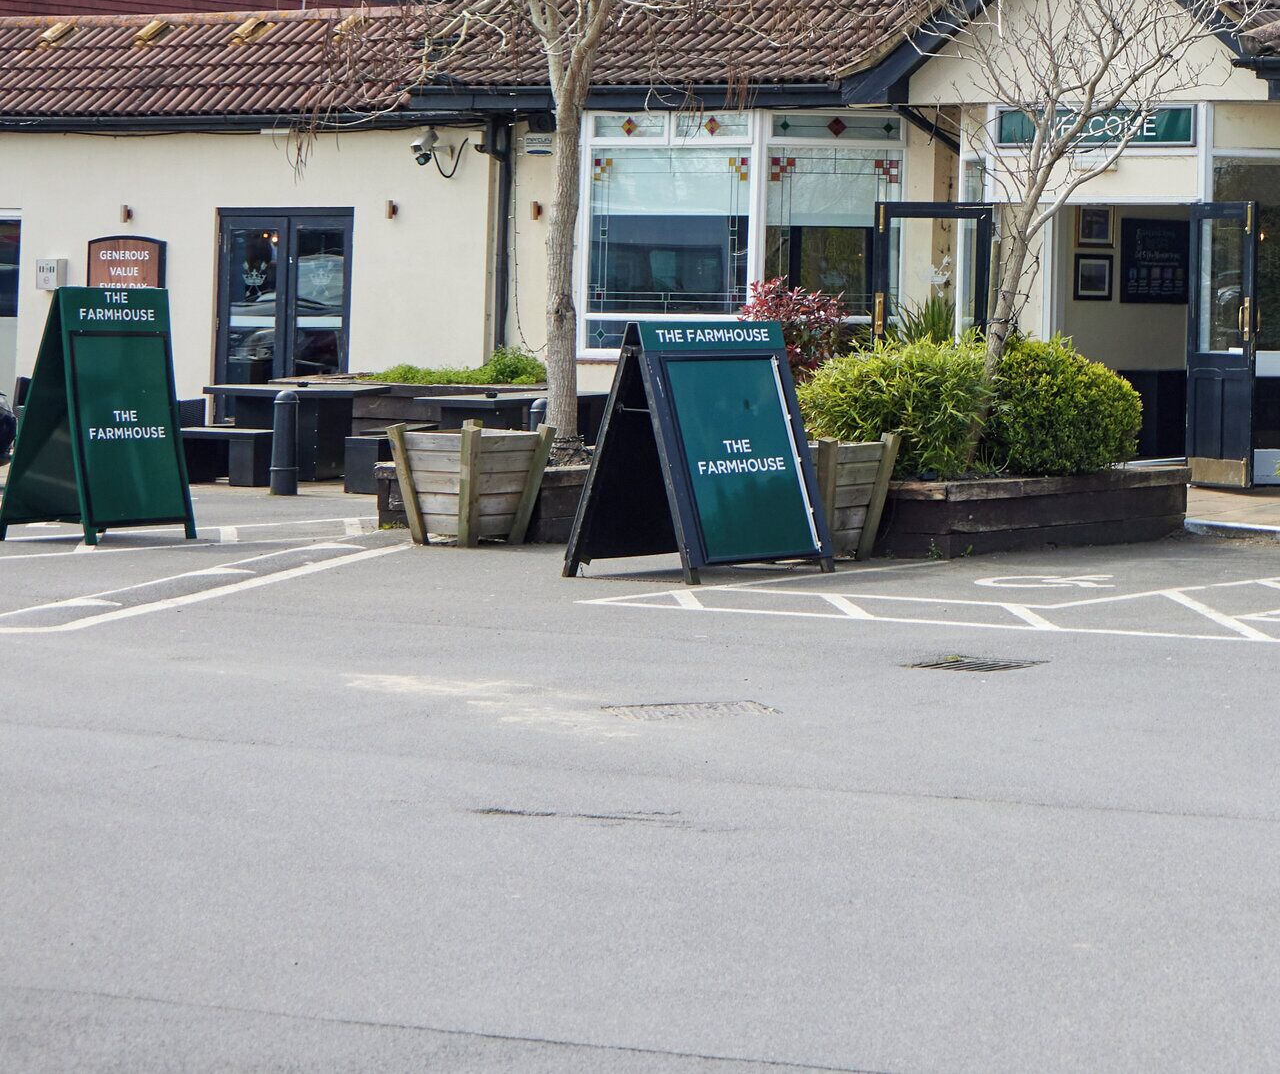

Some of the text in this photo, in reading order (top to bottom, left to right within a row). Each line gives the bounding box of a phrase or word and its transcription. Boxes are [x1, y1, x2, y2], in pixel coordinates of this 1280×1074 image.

[1036, 116, 1157, 136] ELCOME
[99, 250, 150, 260] GENEROUS
[109, 266, 140, 276] VALUE
[104, 292, 129, 304] THE
[80, 308, 155, 321] FARMHOUSE
[655, 328, 770, 343] THE FARMHOUSE
[113, 410, 138, 422] THE
[89, 426, 166, 440] FARMHOUSE
[722, 439, 752, 454] THE
[697, 457, 786, 475] FARMHOUSE
